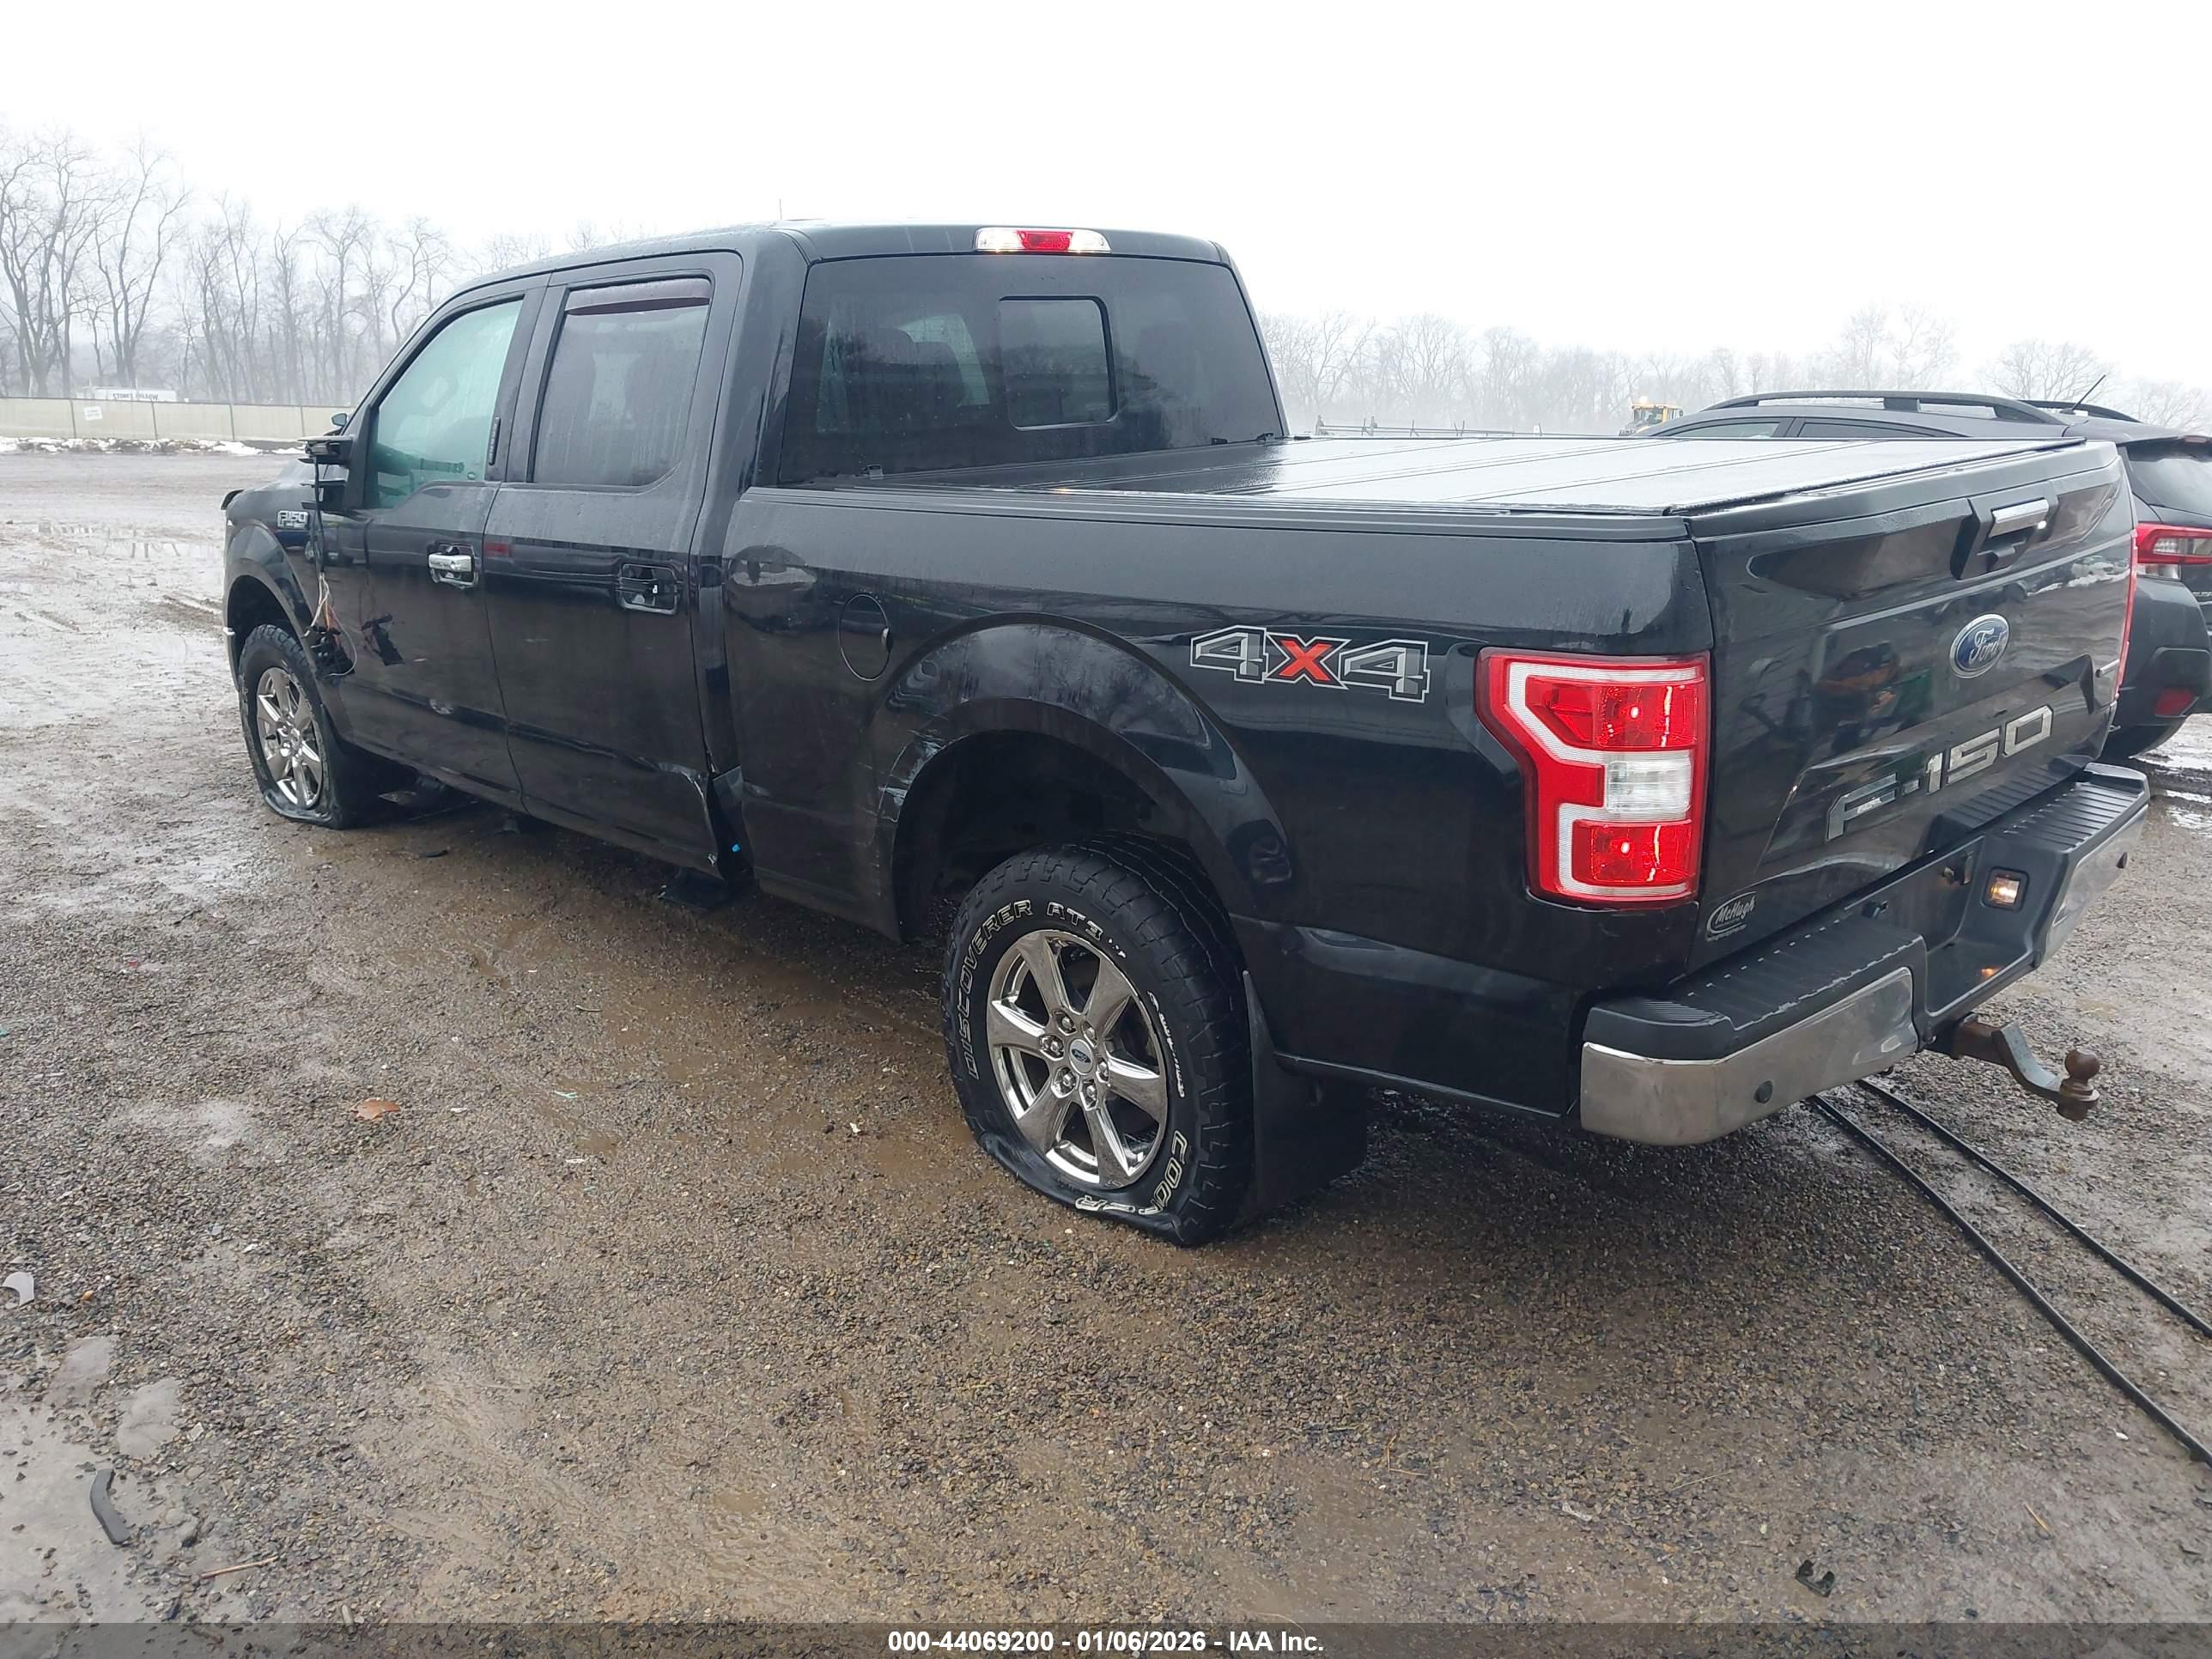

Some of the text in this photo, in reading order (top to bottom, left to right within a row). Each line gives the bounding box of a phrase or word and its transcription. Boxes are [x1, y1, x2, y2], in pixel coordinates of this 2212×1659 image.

[1968, 628, 2007, 665] Ford
[1826, 704, 2053, 842] F-150
[957, 899, 1034, 1080] DISCOVERER
